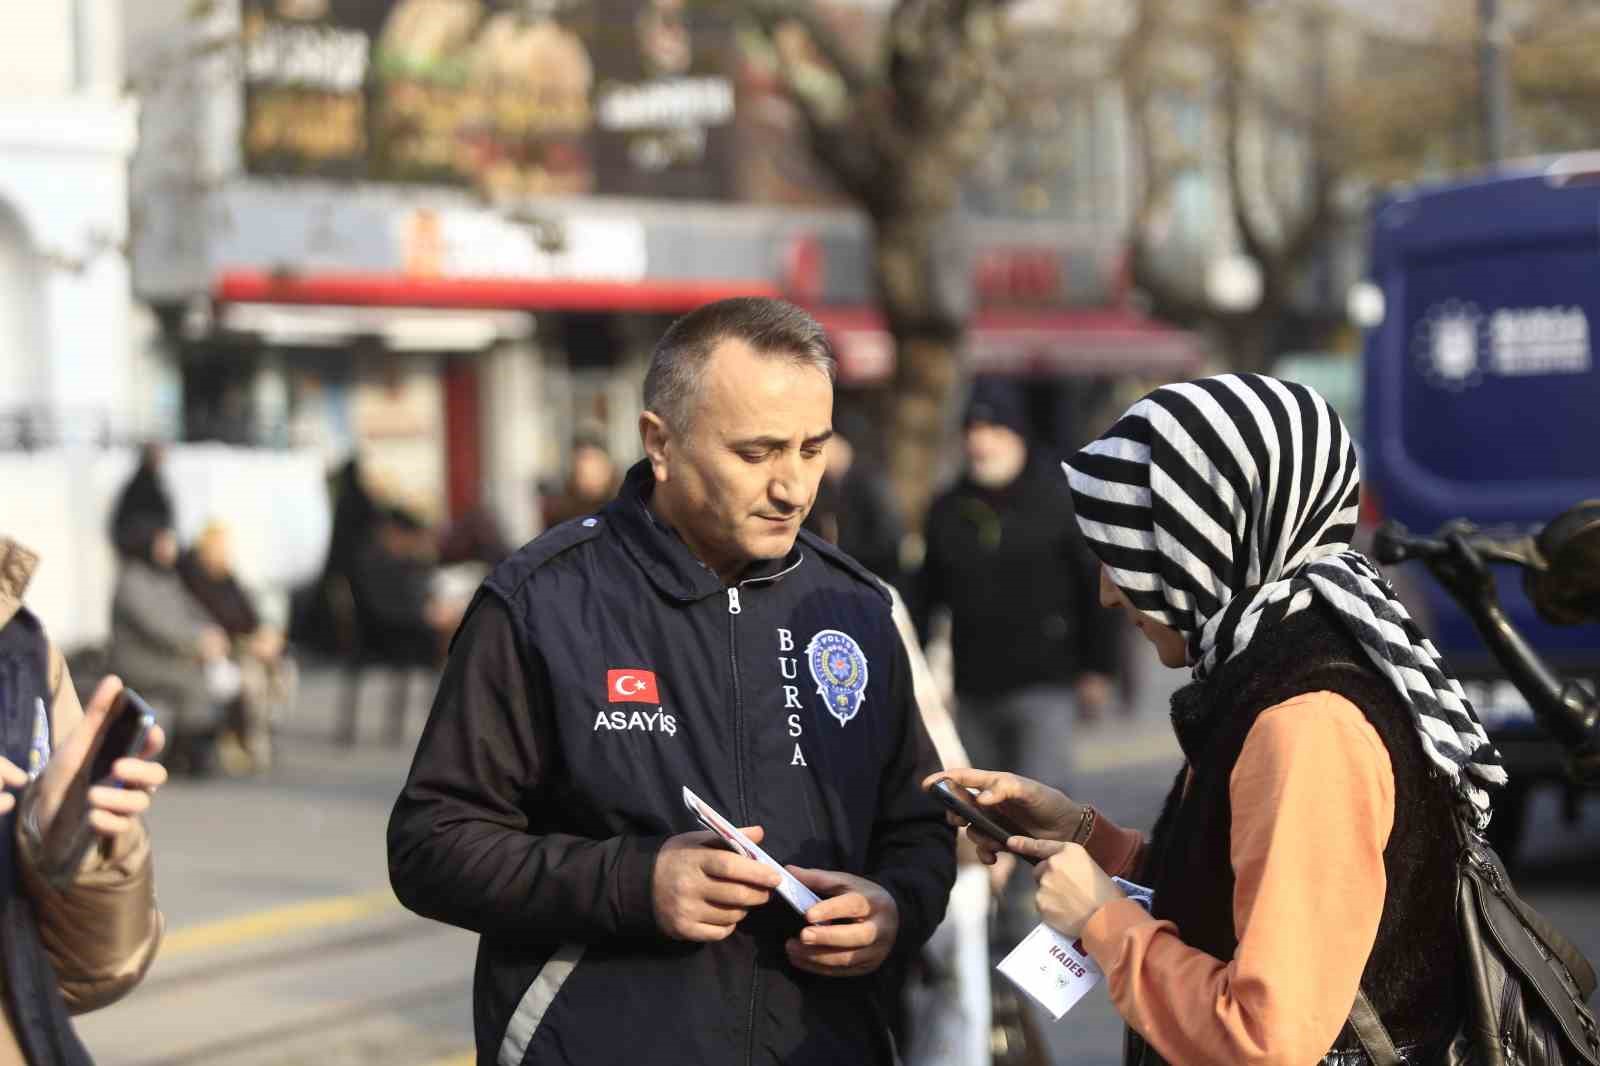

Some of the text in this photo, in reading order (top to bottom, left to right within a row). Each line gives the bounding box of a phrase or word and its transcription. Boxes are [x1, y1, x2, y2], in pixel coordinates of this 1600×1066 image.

[776, 628, 807, 767] BURSA
[594, 706, 677, 737] ASAYİŞ
[1048, 944, 1087, 978] KADES
